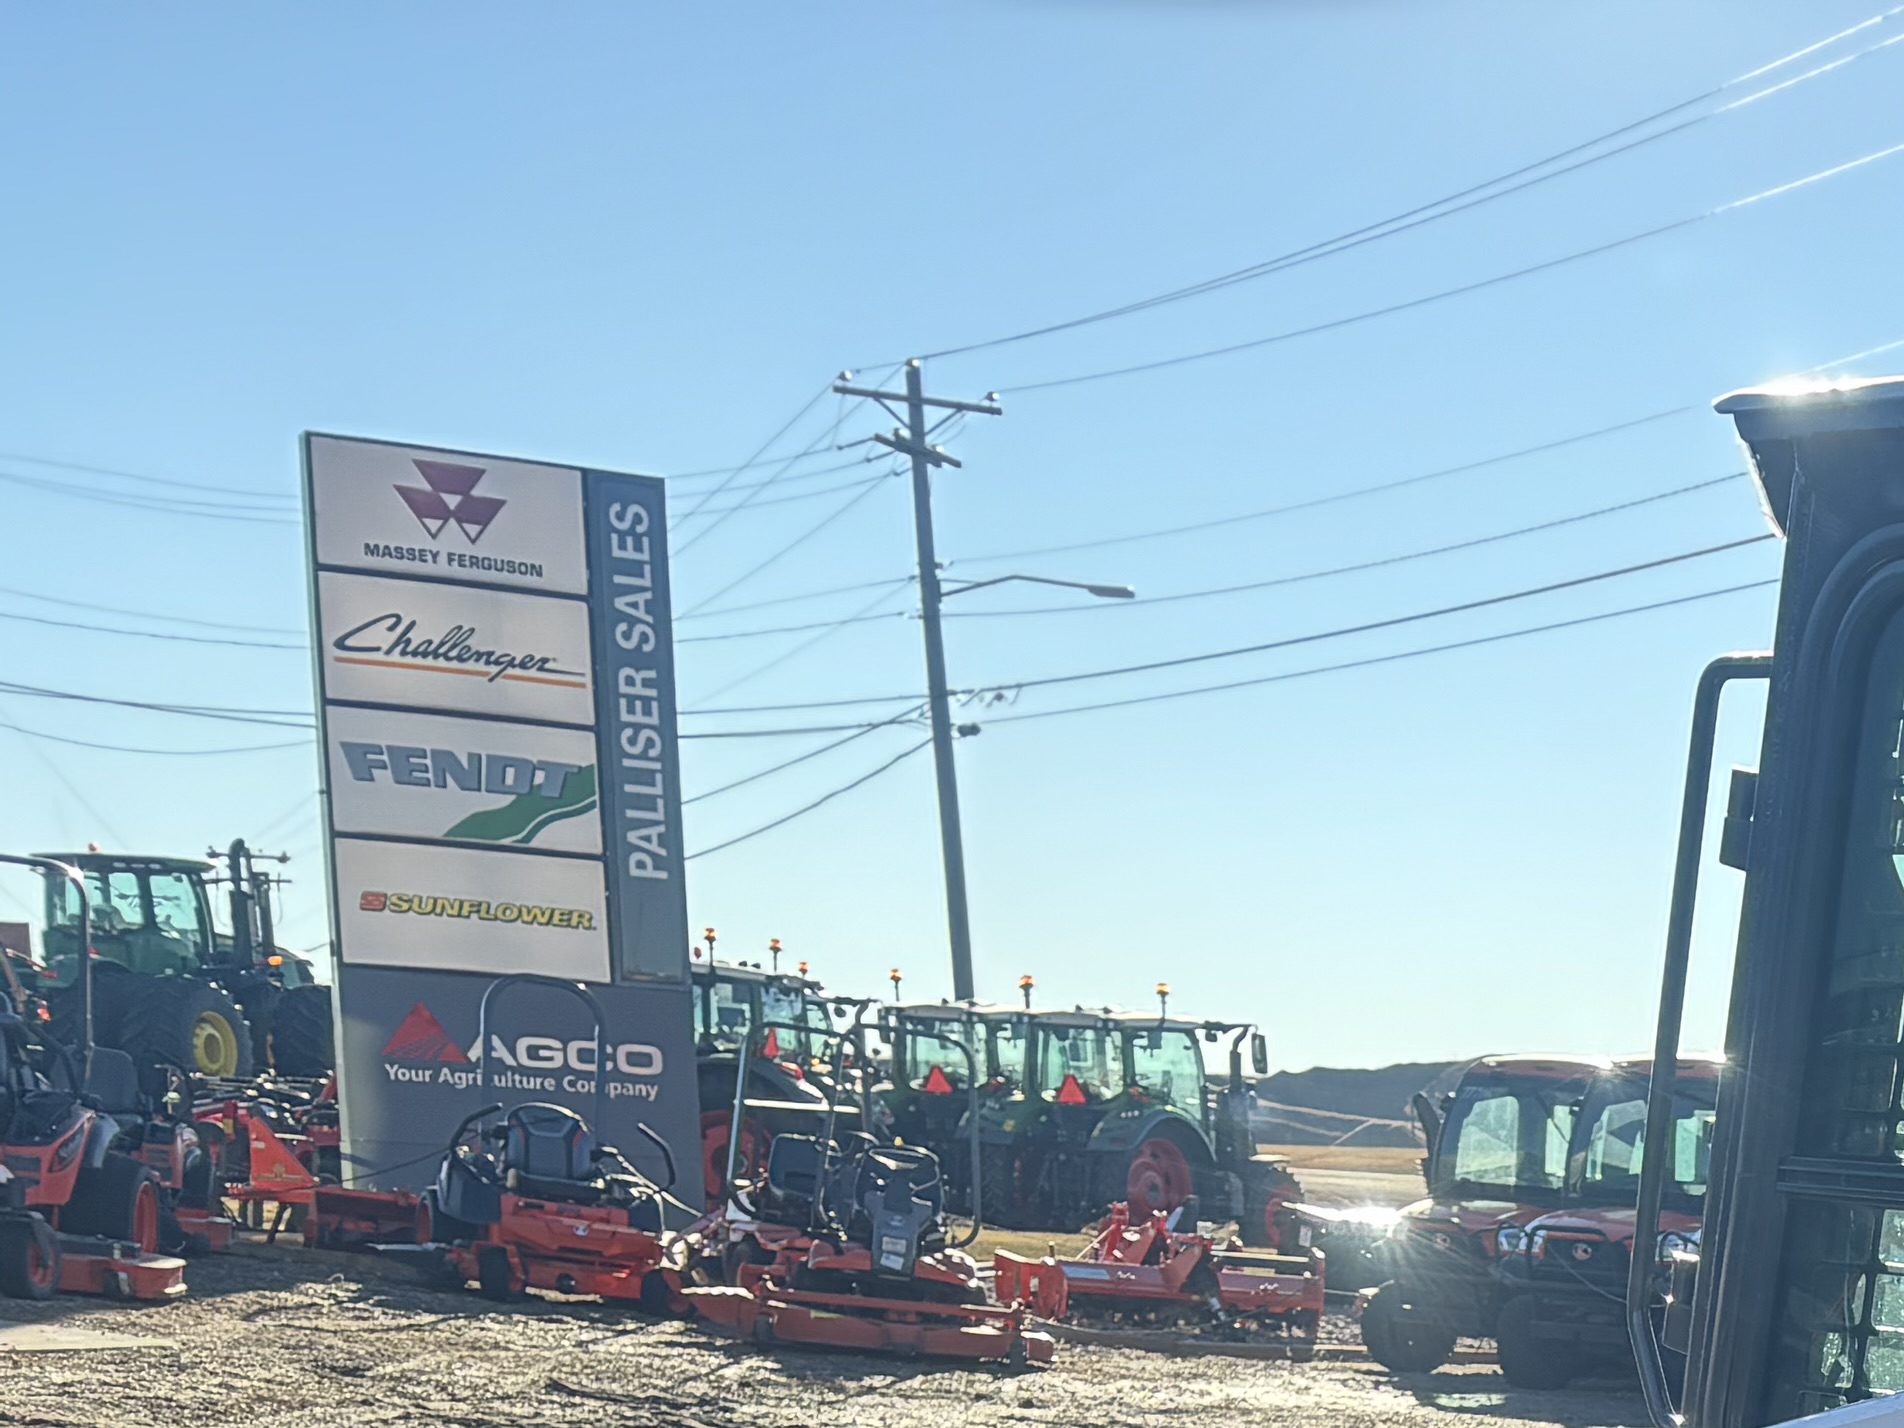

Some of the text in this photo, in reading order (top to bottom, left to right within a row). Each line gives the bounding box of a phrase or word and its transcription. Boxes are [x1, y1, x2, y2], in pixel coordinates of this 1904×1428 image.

[363, 542, 544, 579] MASSEY FERGUSON
[332, 612, 588, 684] Challenger
[608, 501, 669, 880] PALLISER SALES
[339, 740, 584, 799] FENDT
[386, 894, 595, 930] SUNFLOWER
[384, 1063, 433, 1083] Your
[438, 1066, 556, 1090] Agriulture
[467, 1033, 664, 1077] AGCO
